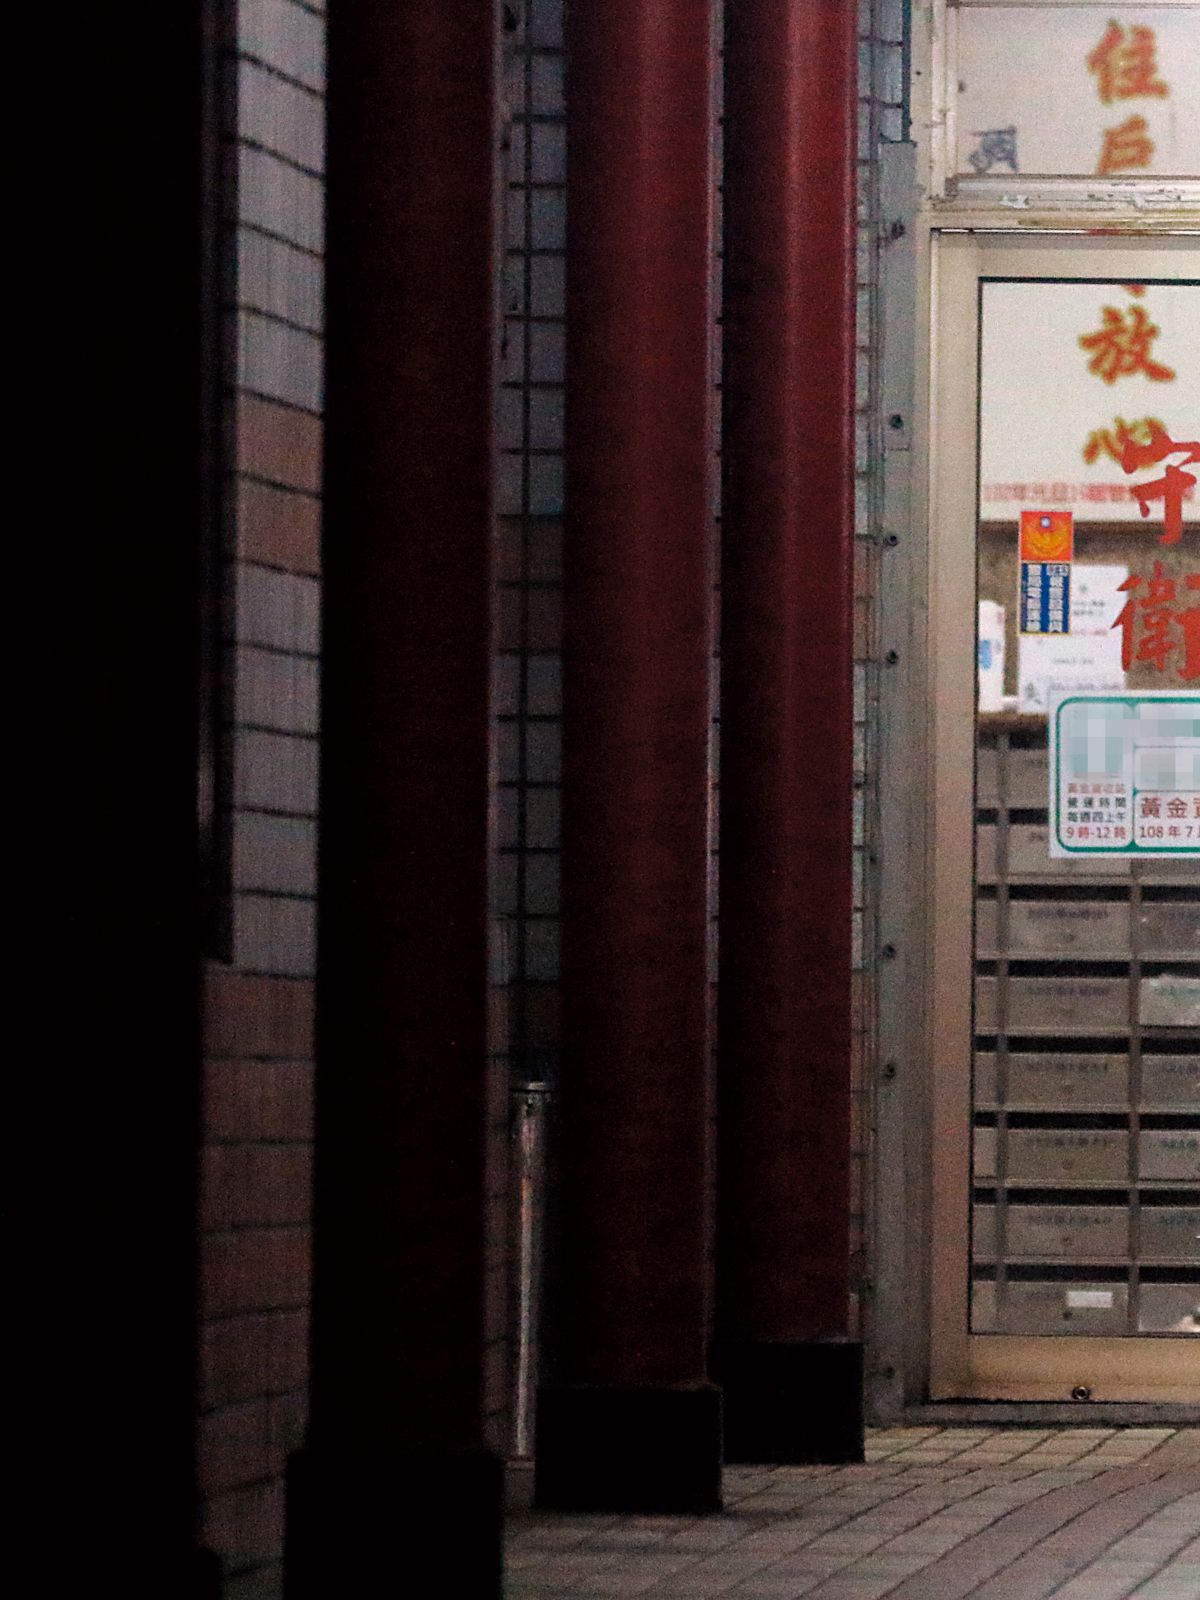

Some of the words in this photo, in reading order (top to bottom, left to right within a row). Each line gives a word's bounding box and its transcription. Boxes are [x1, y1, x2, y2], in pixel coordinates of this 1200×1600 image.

[1087, 18, 1170, 174] 住戶
[1067, 797, 1126, 809] 營運時間
[1067, 811, 1126, 823] 每週四上午
